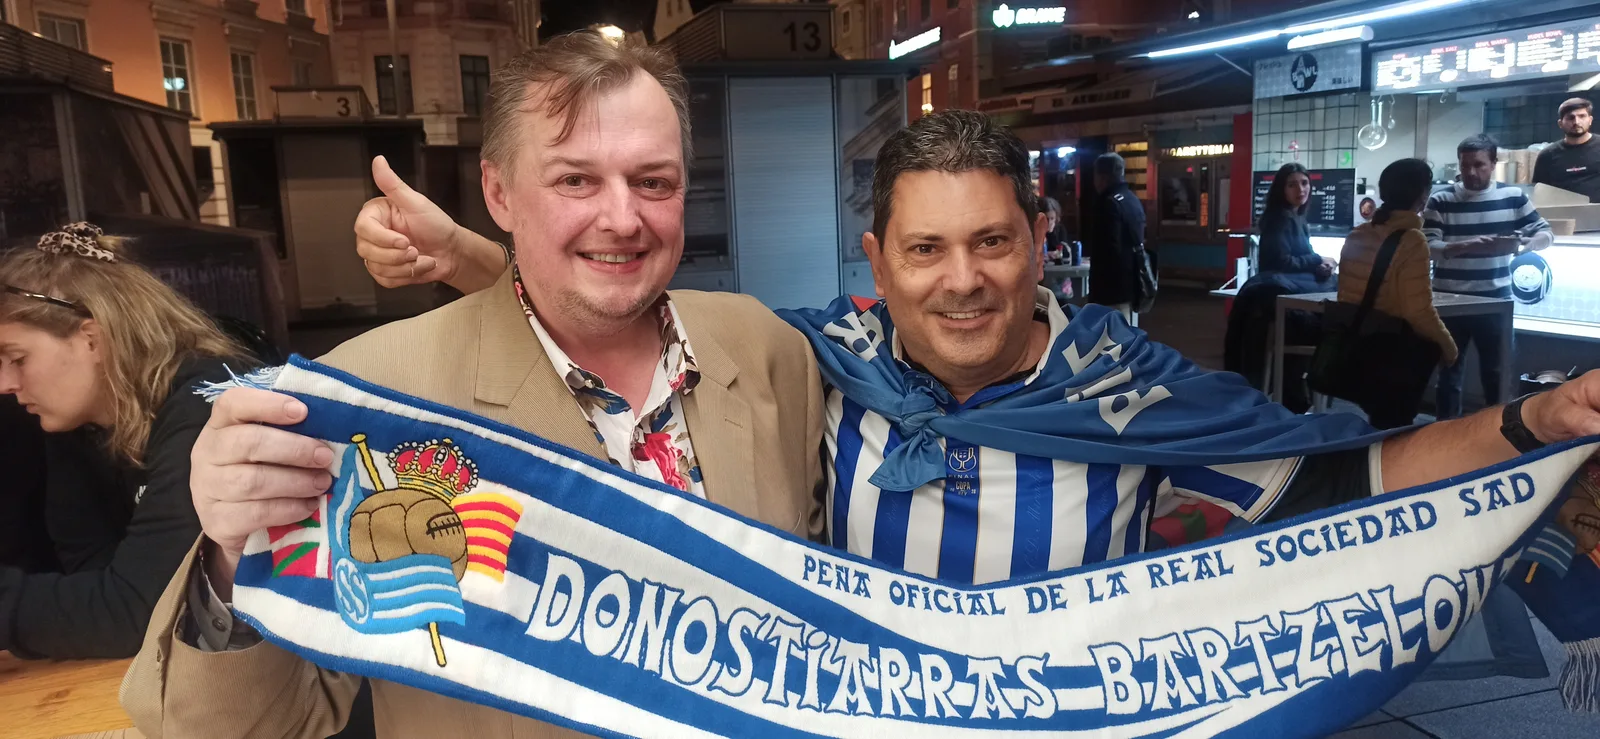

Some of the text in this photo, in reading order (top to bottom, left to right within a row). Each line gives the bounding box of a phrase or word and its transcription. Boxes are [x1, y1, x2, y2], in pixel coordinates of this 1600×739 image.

[783, 21, 822, 52] 13
[337, 97, 351, 117] 3
[889, 580, 1006, 616] OFICIAL
[1024, 583, 1069, 615] DE
[1085, 571, 1130, 604] LA
[1146, 549, 1235, 590] REAL
[1255, 501, 1438, 568] SOCIEDAD
[1459, 471, 1537, 517] SAD
[524, 546, 1524, 721] DONOSTIARRAS BARTZELON
